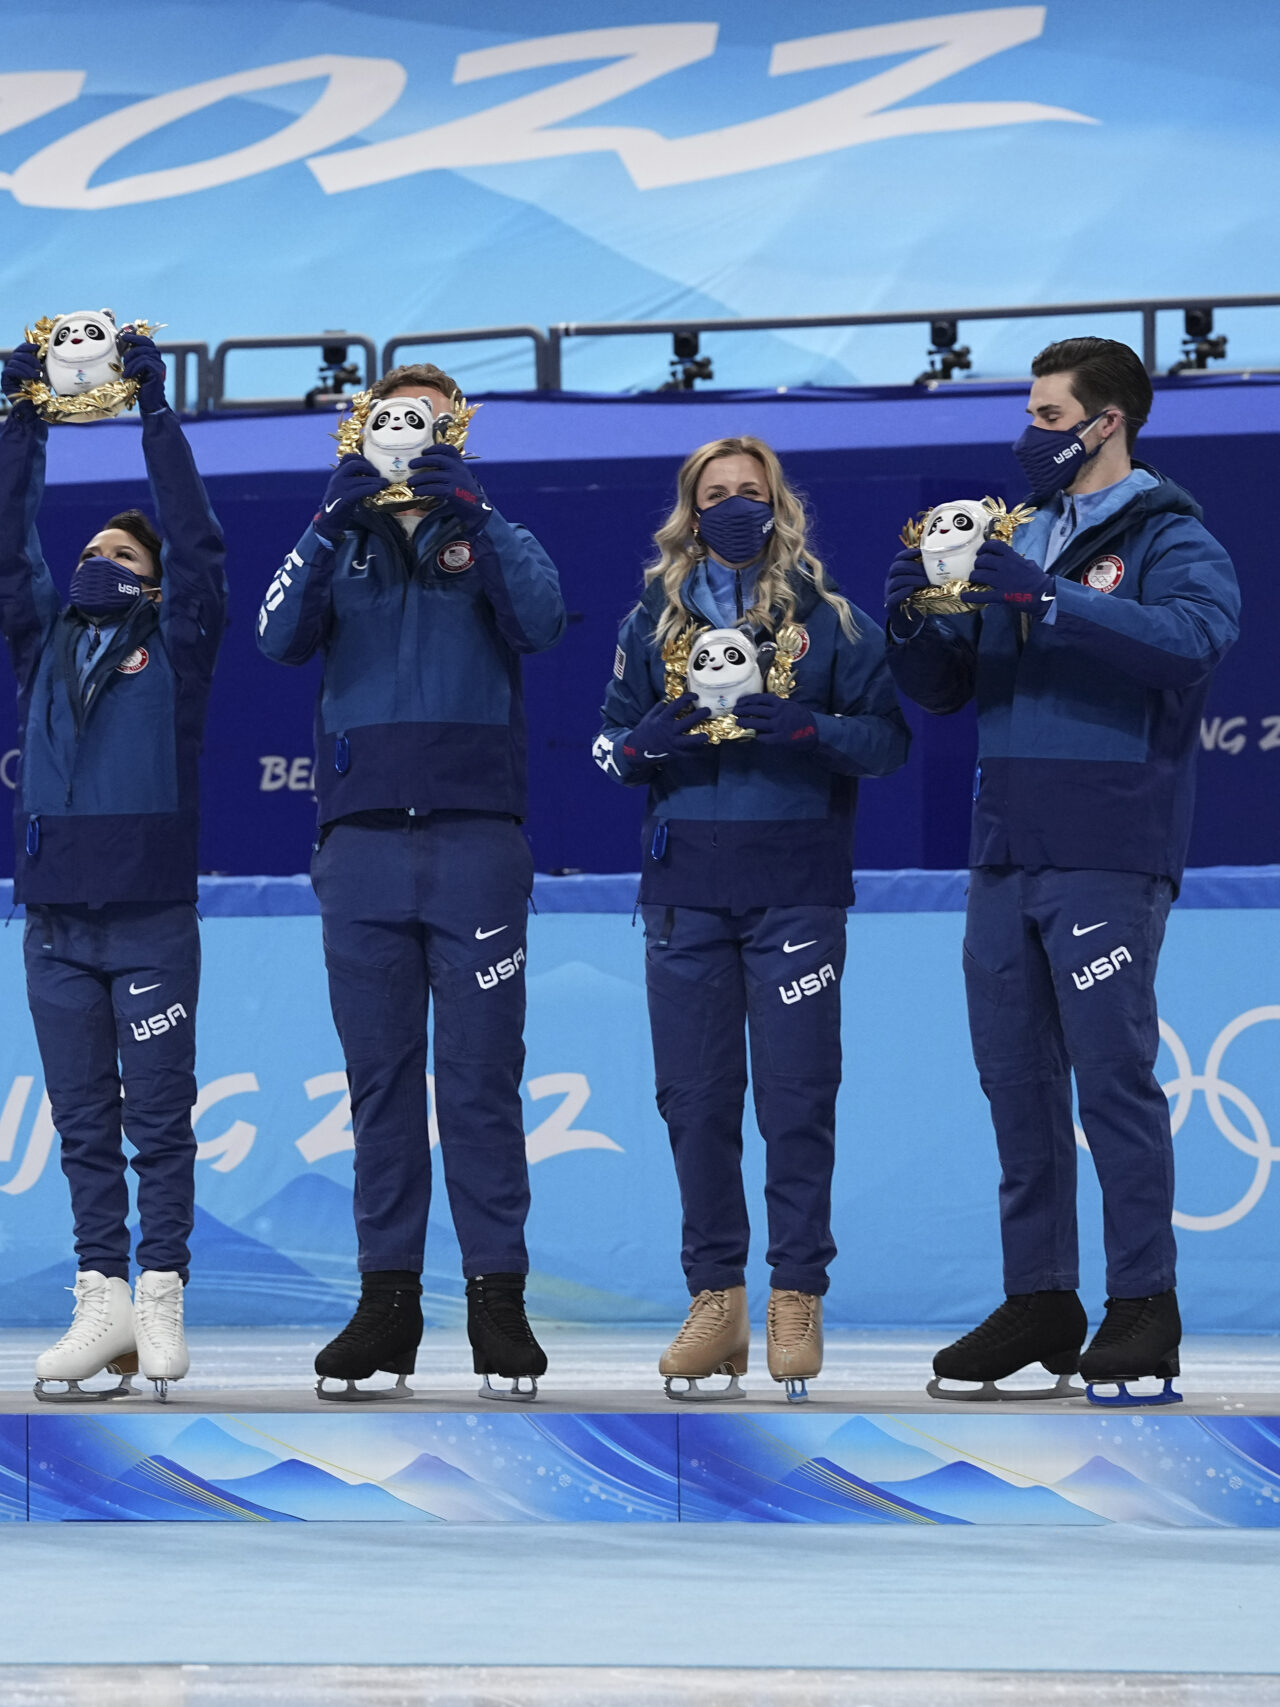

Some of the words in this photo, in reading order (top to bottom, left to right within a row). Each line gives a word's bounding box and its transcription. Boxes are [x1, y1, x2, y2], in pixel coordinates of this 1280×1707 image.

[1053, 442, 1082, 464] USA
[117, 582, 140, 597] USA
[1004, 592, 1032, 603] USA
[475, 947, 524, 990] USA
[778, 963, 836, 1005] USA
[1070, 946, 1133, 990] USA
[130, 1003, 187, 1042] USA
